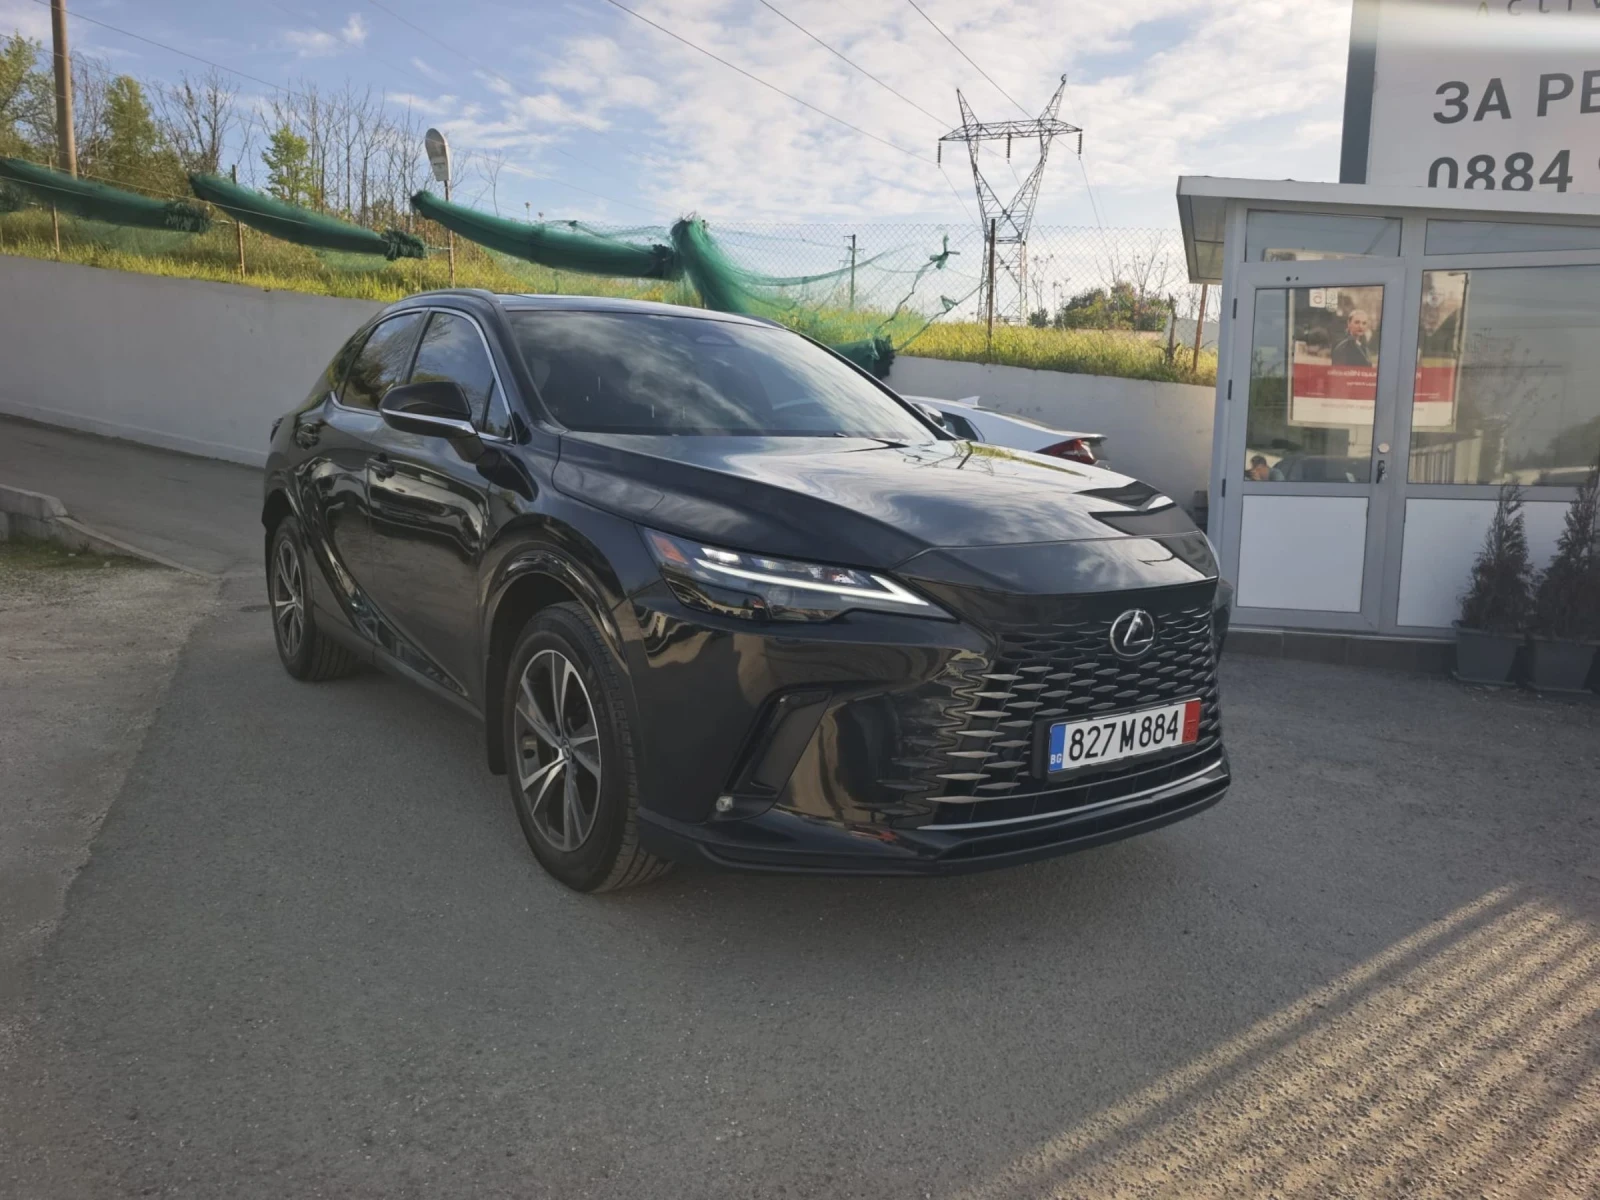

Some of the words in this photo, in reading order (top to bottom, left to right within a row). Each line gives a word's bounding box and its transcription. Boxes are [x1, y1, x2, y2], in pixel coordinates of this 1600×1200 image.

[1433, 77, 1512, 124] ЗА
[1427, 150, 1573, 193] 0884
[1050, 753, 1062, 765] BG
